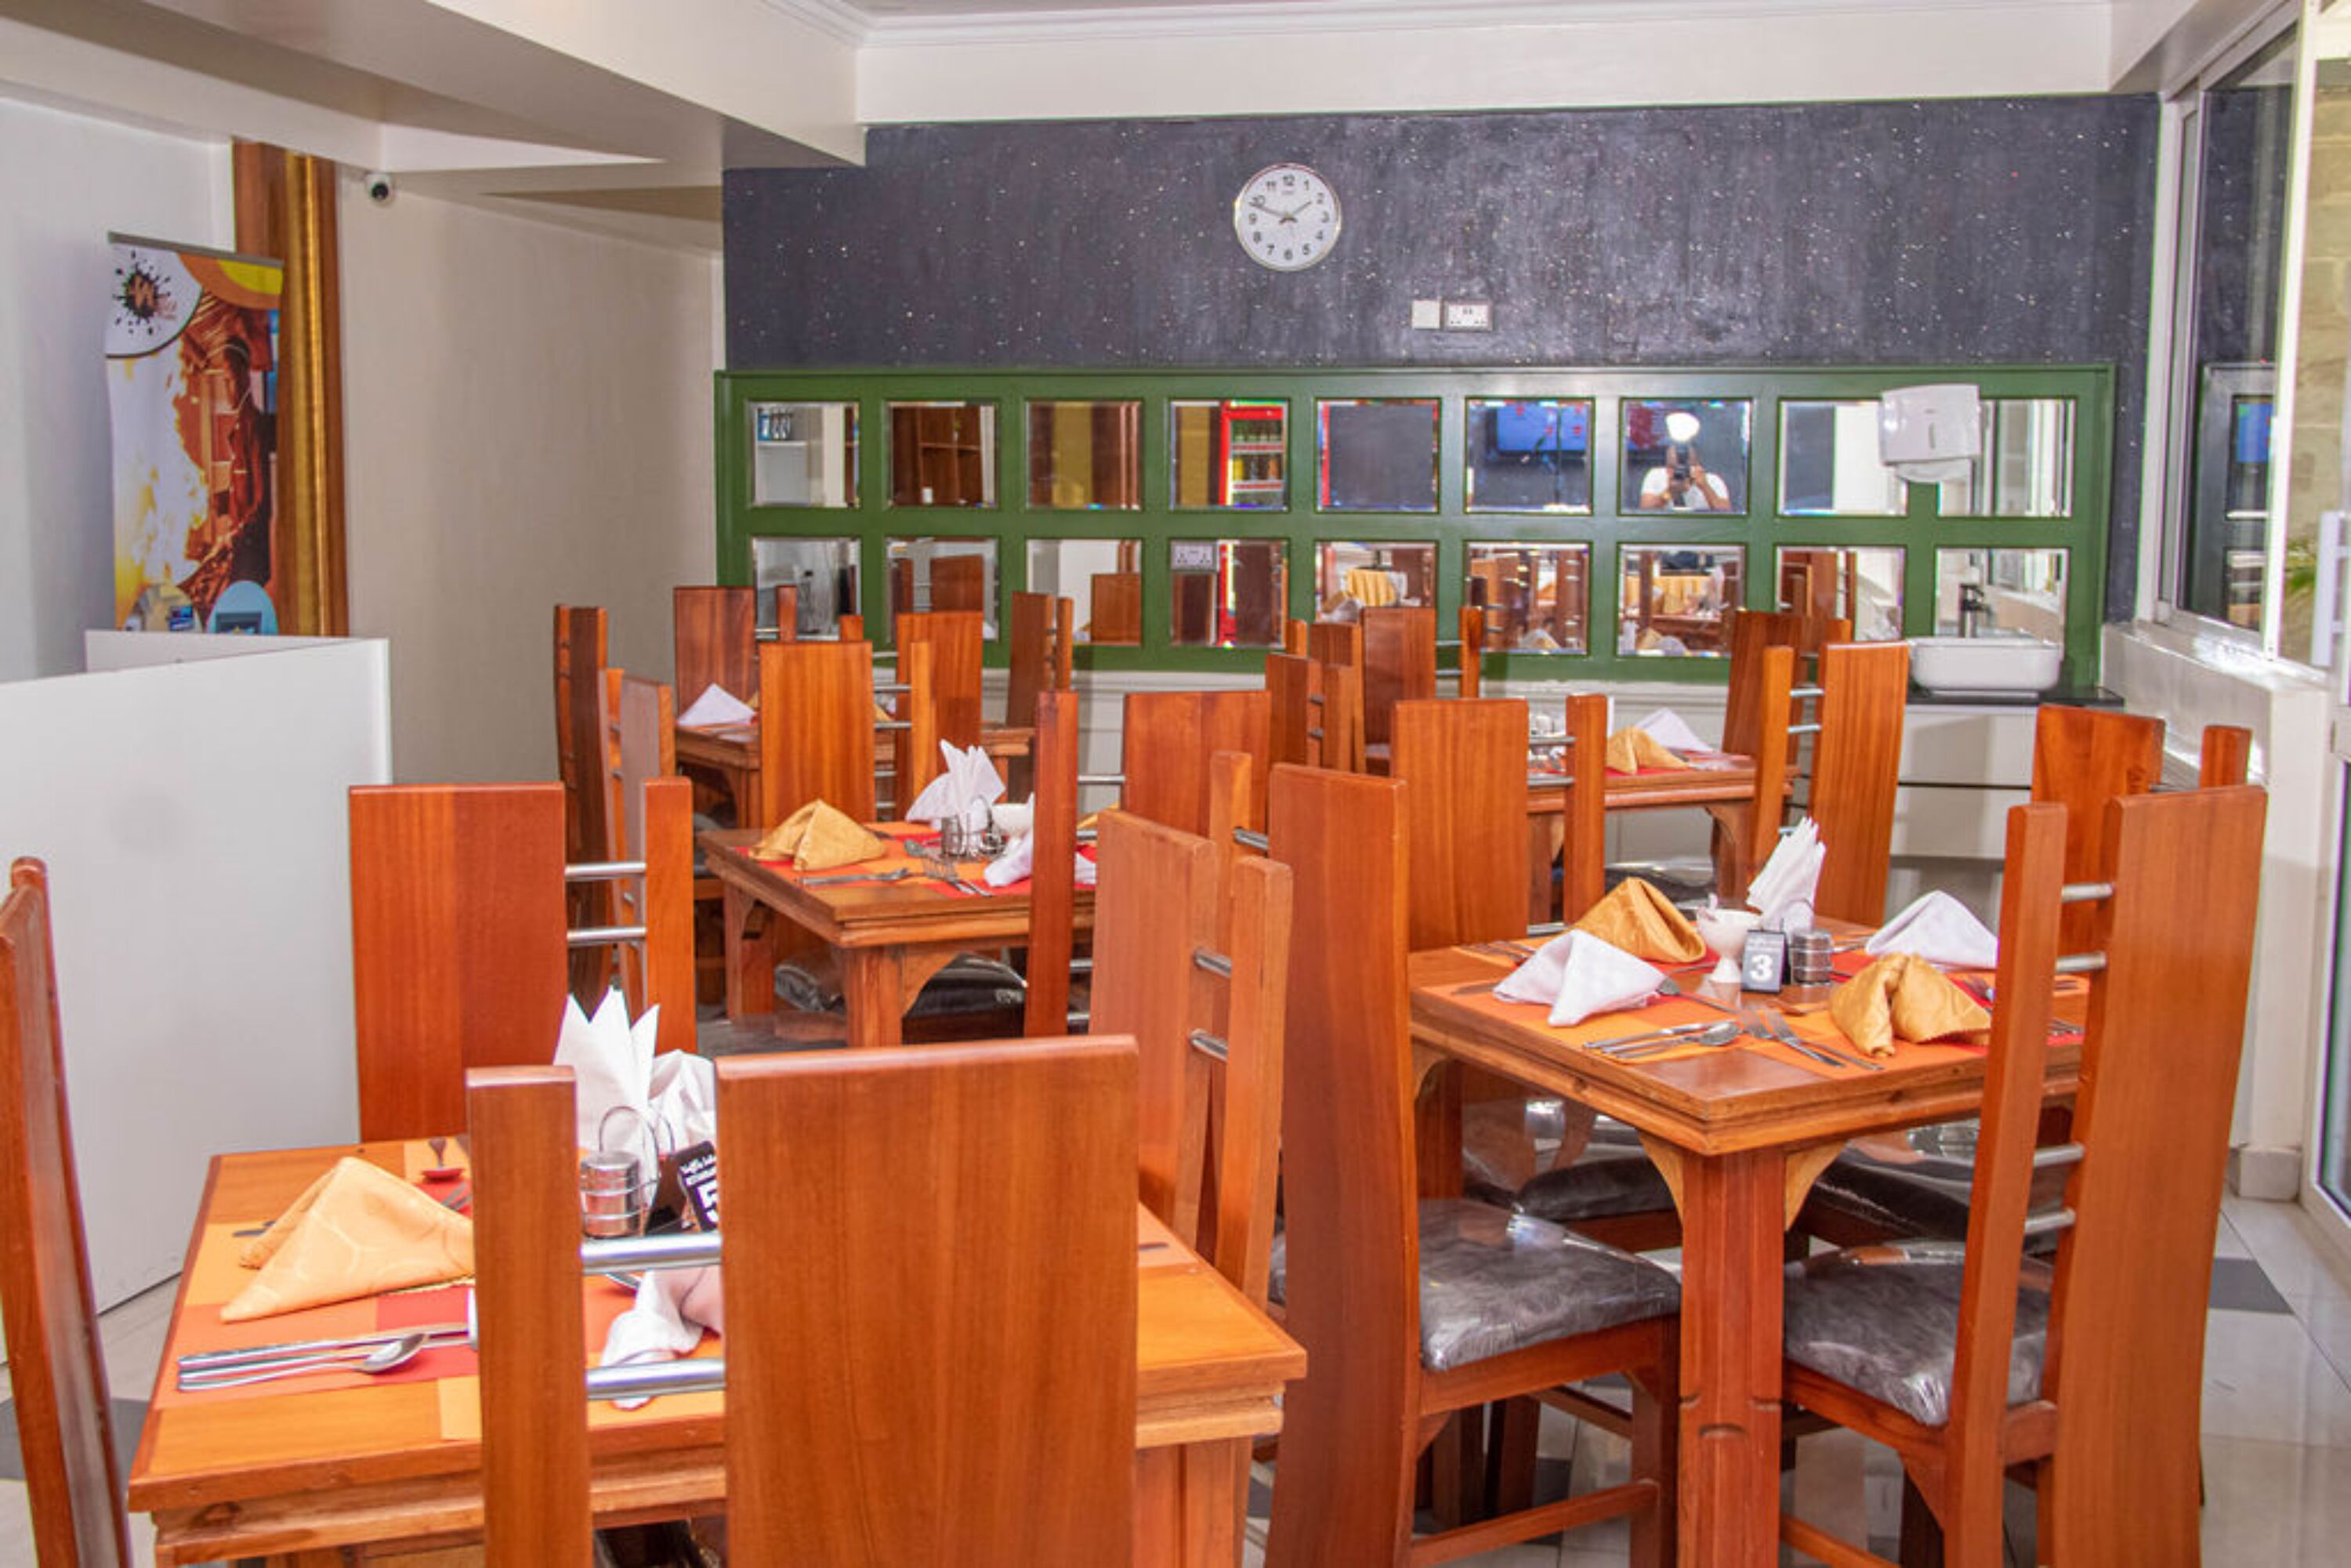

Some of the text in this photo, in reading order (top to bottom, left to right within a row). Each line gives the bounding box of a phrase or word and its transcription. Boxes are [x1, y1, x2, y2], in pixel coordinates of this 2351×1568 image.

[1283, 174, 1295, 186] 12
[1304, 179, 1309, 190] 1
[1266, 181, 1276, 191] 11
[1252, 195, 1266, 205] 10
[1317, 193, 1324, 204] 2
[1249, 213, 1257, 224] 9
[1322, 212, 1329, 223] 3
[1253, 231, 1261, 244] 8
[1315, 230, 1323, 241] 4
[1267, 244, 1275, 255] 7
[1284, 249, 1292, 260] 6
[1303, 244, 1310, 255] 5
[1750, 954, 1772, 981] 3
